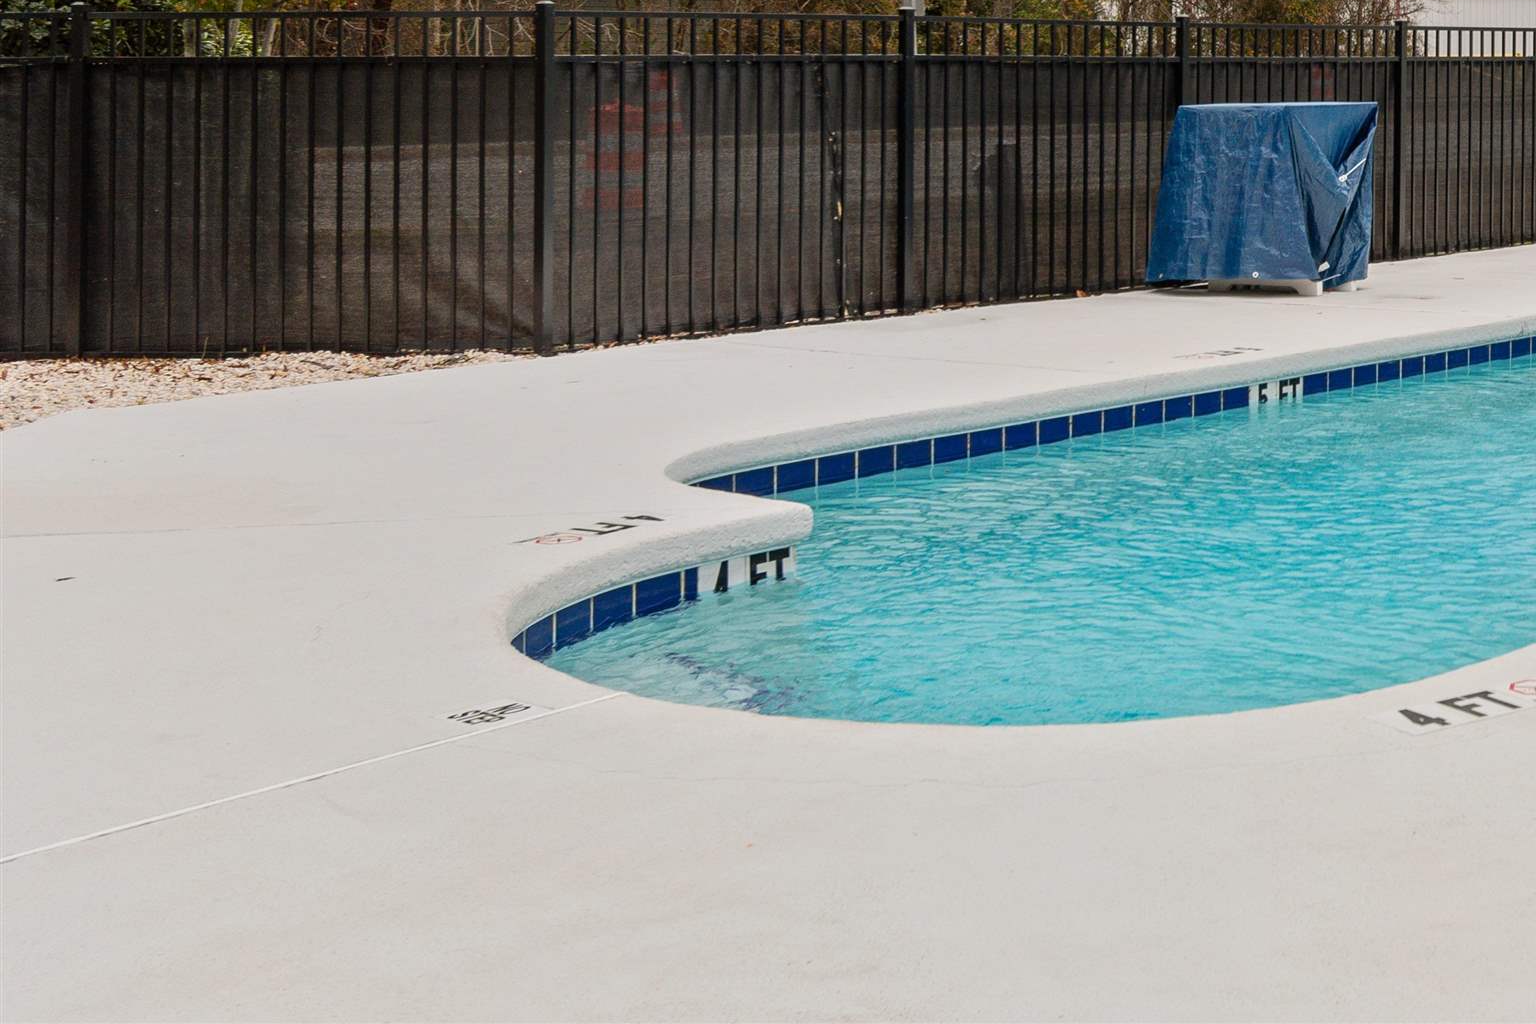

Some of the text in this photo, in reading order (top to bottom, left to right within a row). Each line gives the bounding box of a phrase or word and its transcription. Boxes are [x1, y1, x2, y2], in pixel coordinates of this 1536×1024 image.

[1258, 377, 1301, 404] 5 FT
[569, 522, 641, 536] FT
[749, 546, 790, 587] FT
[1397, 690, 1523, 727] 4 FT
